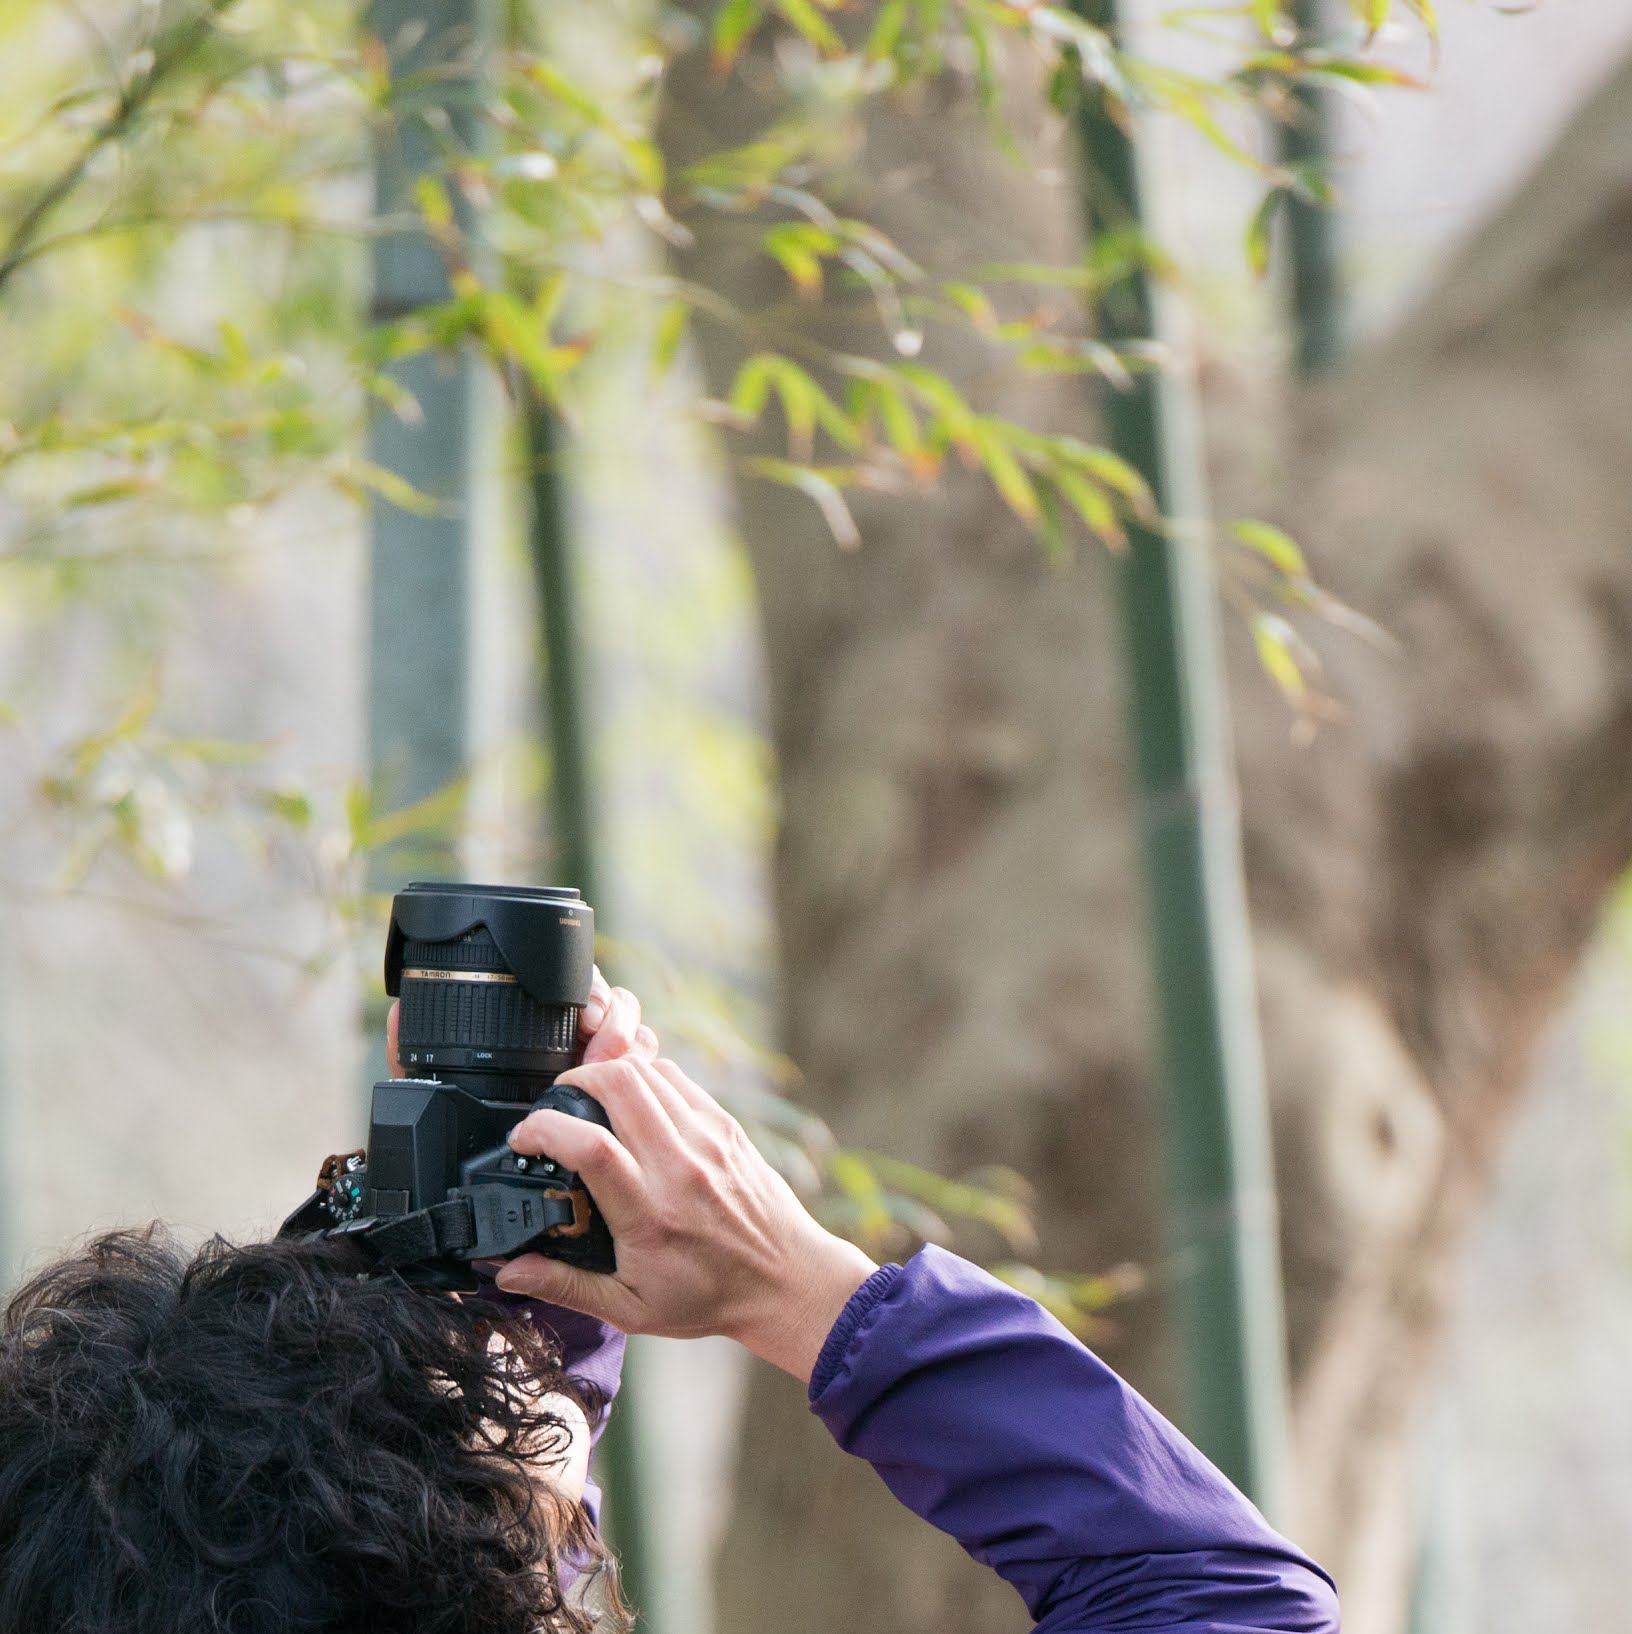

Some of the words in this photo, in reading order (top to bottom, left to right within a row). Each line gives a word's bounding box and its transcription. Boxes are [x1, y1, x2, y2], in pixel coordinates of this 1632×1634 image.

[421, 970, 451, 978] TAMRON
[410, 1053, 417, 1062] 24
[426, 1054, 434, 1063] 17
